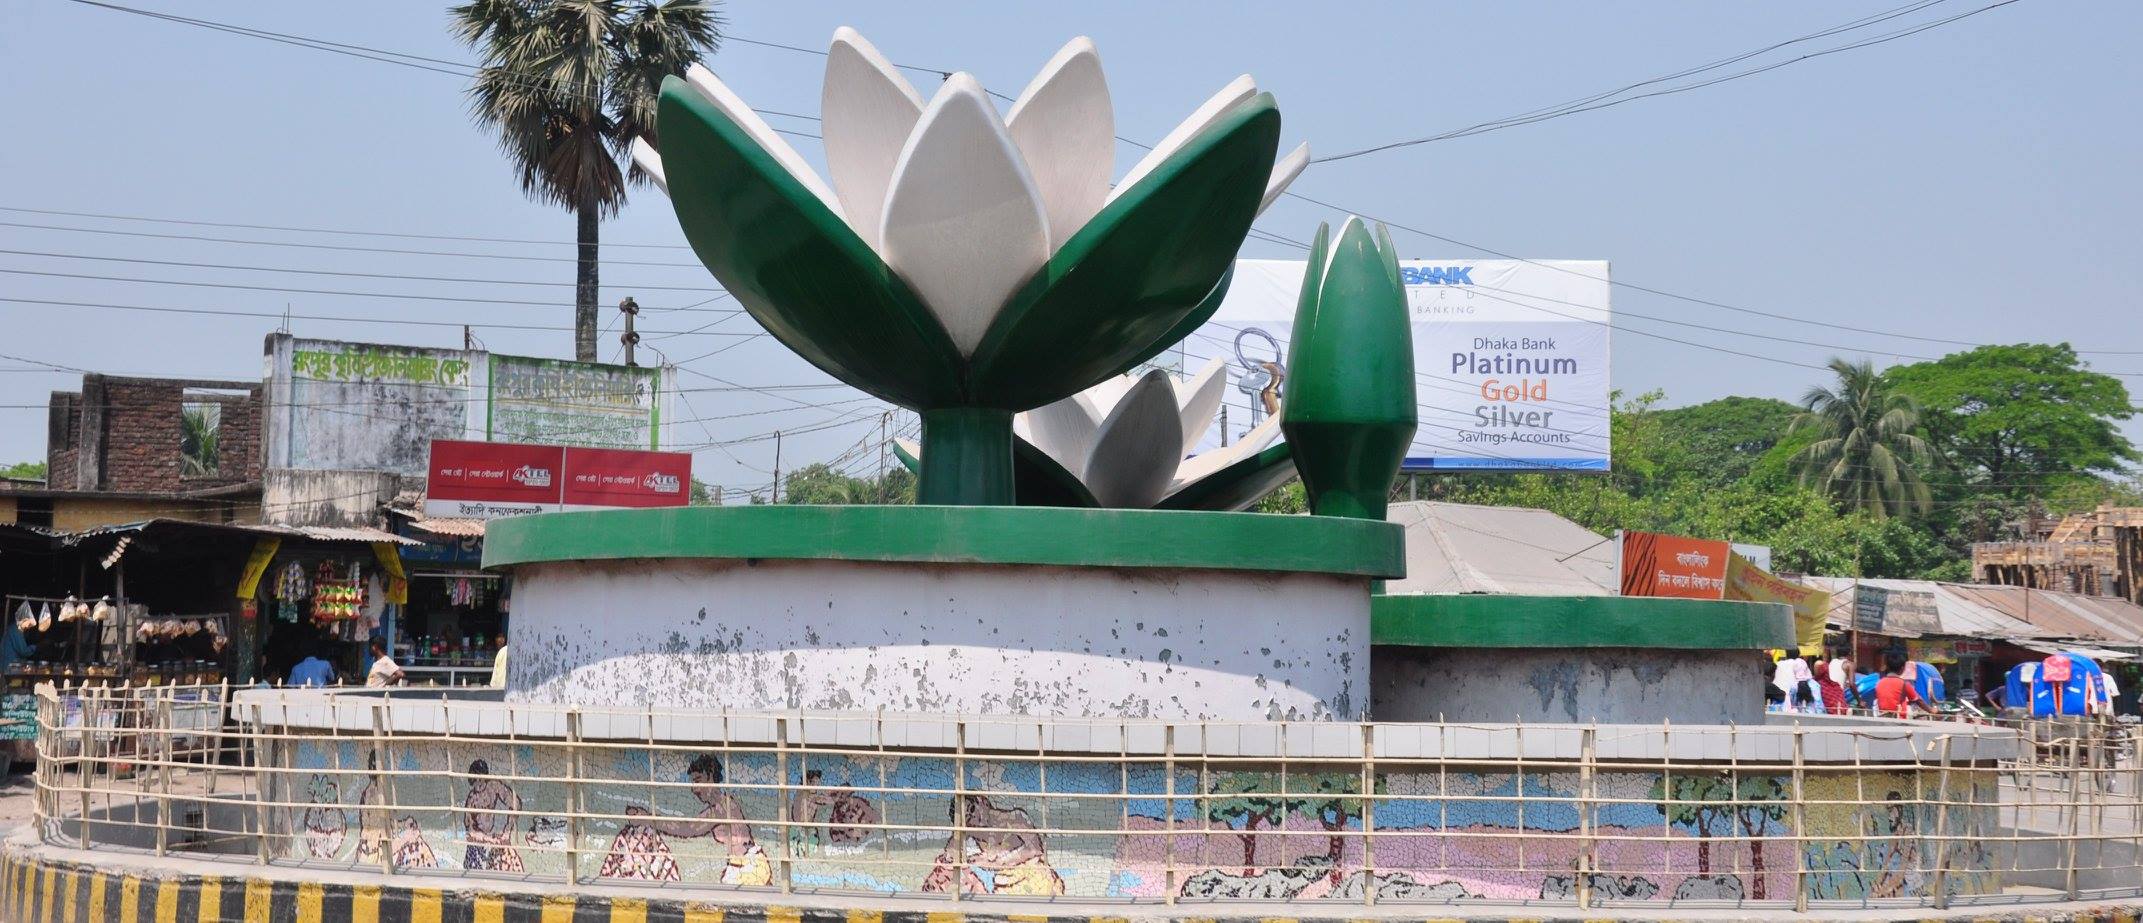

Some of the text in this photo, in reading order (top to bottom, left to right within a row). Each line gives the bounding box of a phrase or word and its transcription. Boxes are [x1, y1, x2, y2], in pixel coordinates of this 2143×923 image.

[1401, 266, 1474, 285] BANK
[1417, 305, 1474, 314] BANKING
[1474, 337, 1556, 350] Dhaka Bank
[1452, 352, 1577, 375] Platinum
[1481, 378, 1547, 402] Gold
[1474, 405, 1553, 428] Silver
[1458, 430, 1571, 445] Savings Accounts
